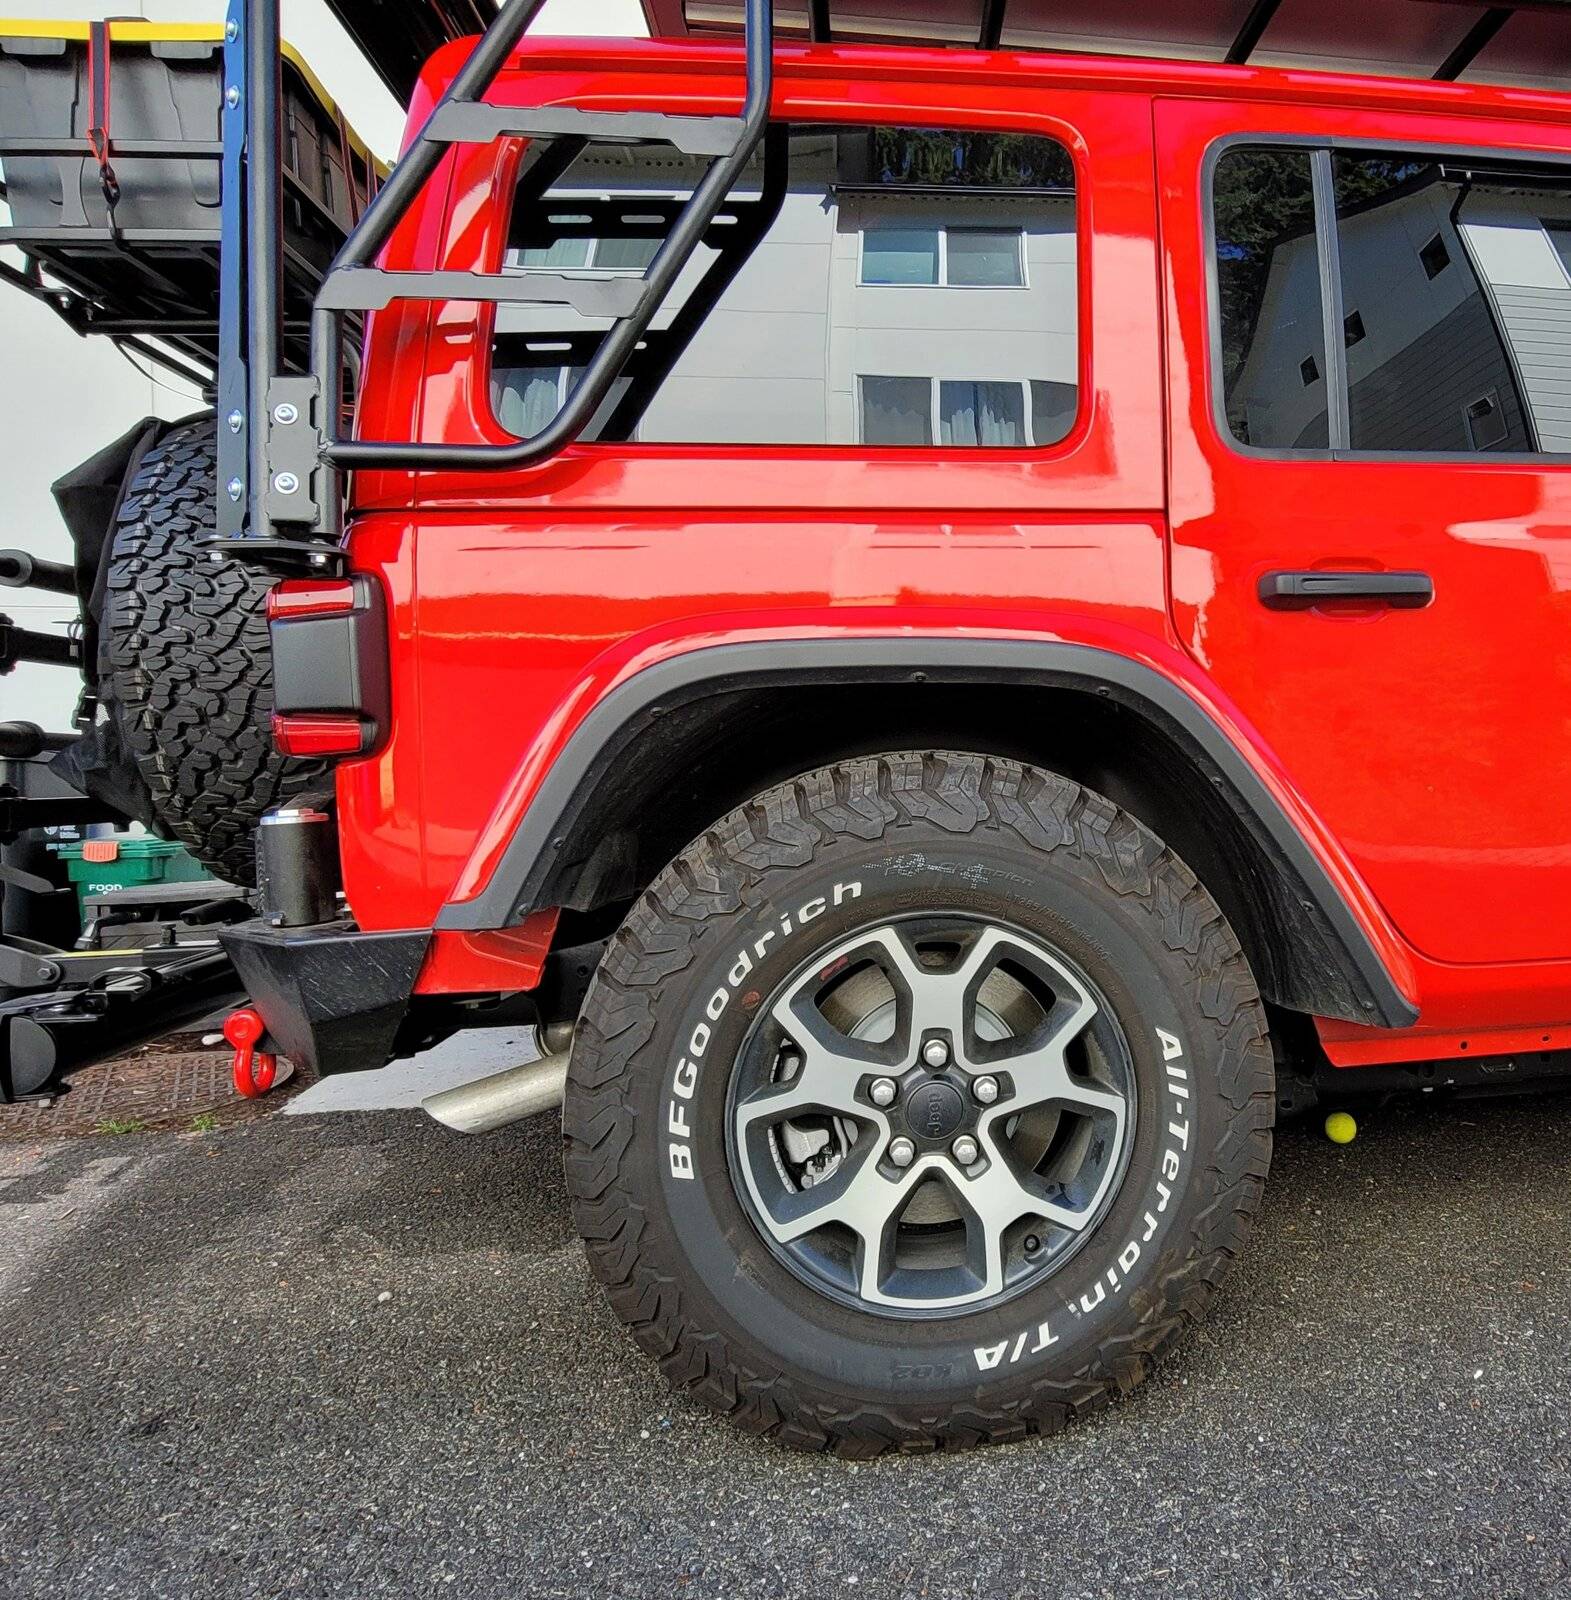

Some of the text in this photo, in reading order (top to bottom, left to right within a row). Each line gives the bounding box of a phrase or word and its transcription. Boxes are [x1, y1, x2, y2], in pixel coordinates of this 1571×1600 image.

[88, 884, 123, 892] FOOD
[668, 881, 862, 1180] BFGoodrich
[927, 1093, 943, 1135] Jeep
[1080, 1027, 1189, 1313] All-Terrain
[973, 1321, 1060, 1371] T/A
